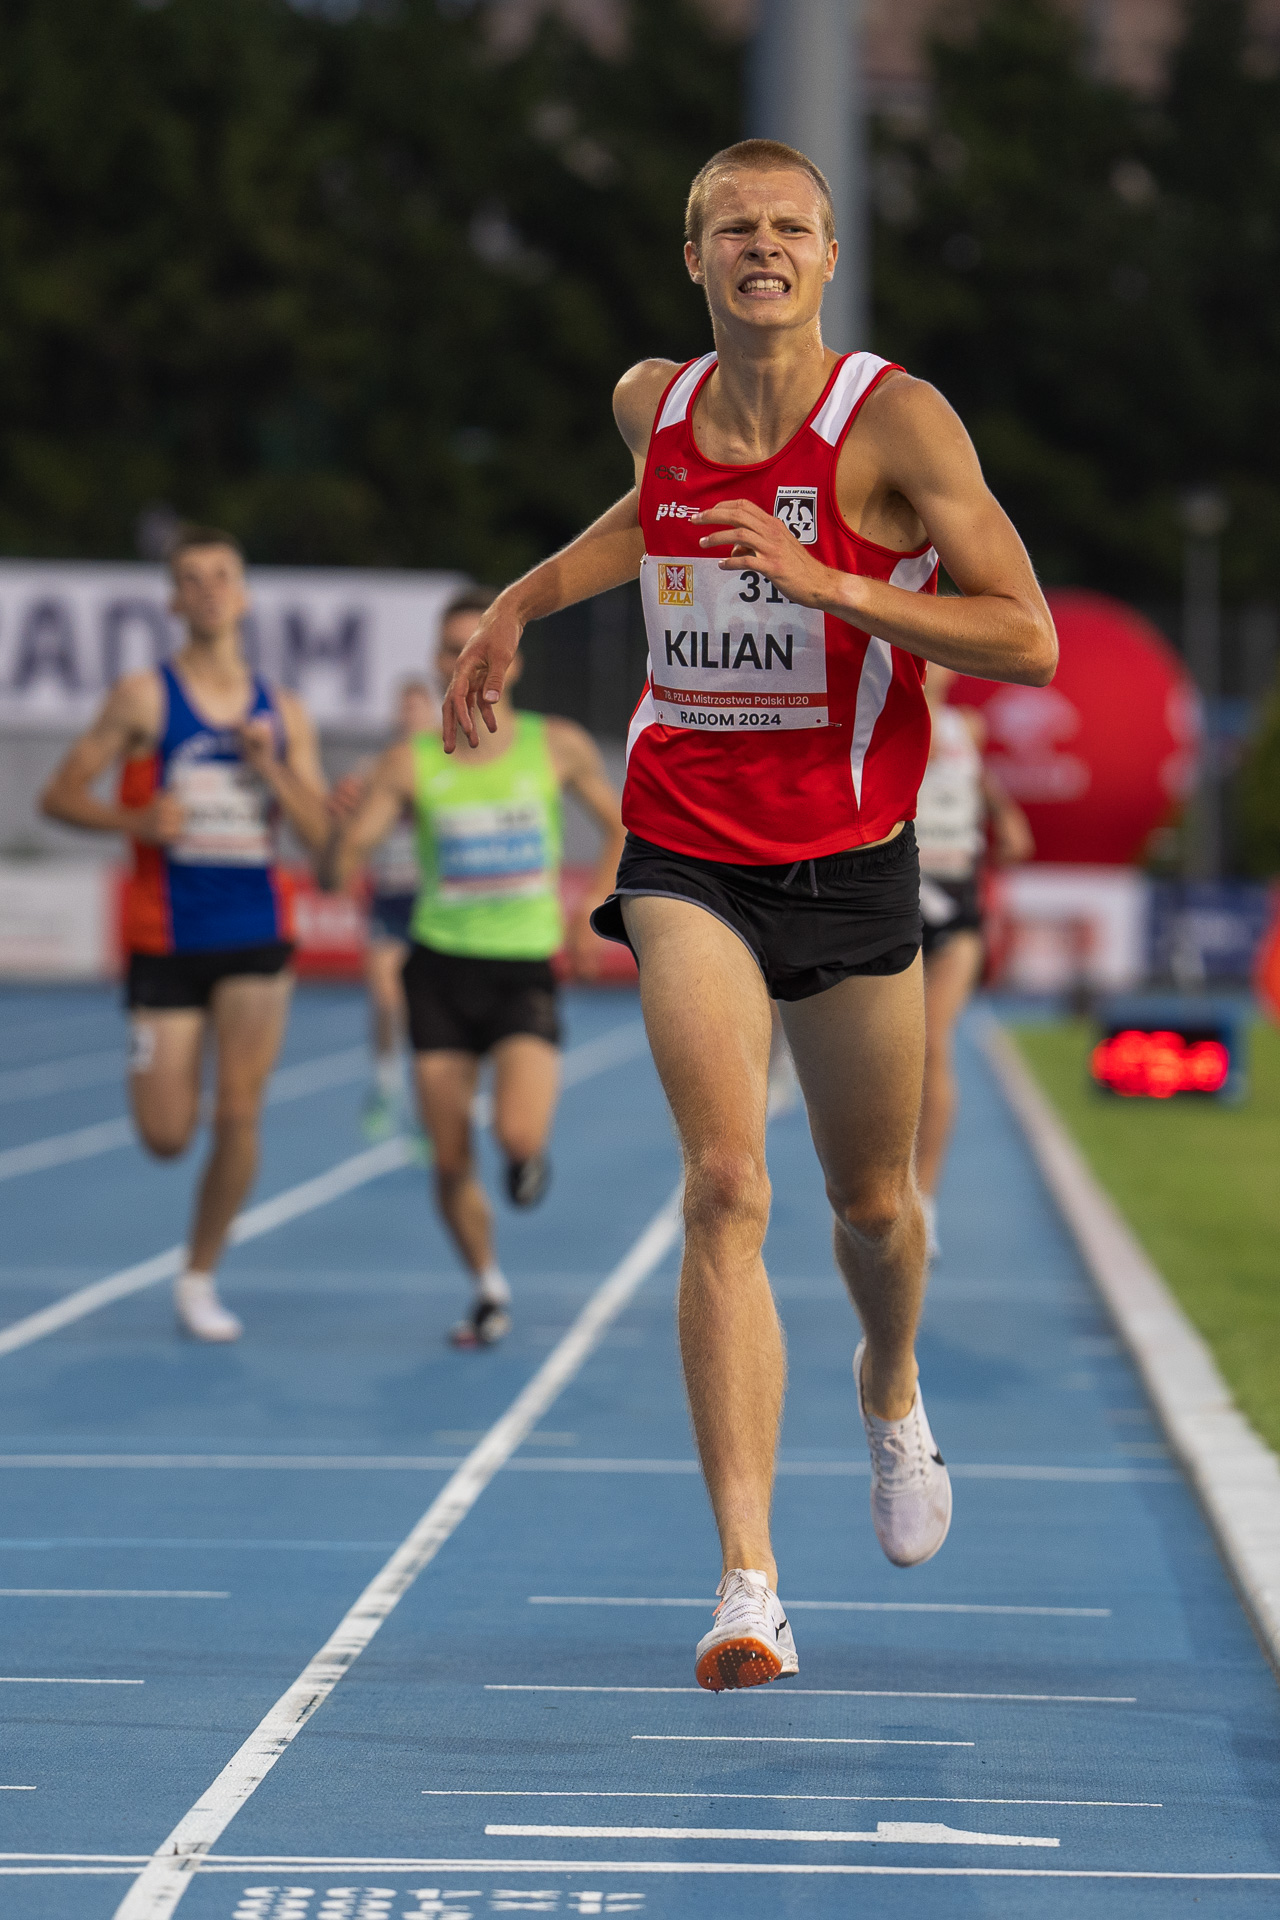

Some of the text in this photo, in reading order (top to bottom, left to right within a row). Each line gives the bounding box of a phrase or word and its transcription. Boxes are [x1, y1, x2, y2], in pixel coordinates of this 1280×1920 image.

[738, 570, 800, 604] 31
[660, 592, 692, 604] PZLA
[664, 629, 794, 671] KILIAN
[673, 692, 691, 703] PZLA
[693, 693, 752, 705] Mistrzostwa
[754, 696, 786, 706] Polski
[788, 696, 809, 705] U20
[680, 710, 782, 726] RADOM 2024
